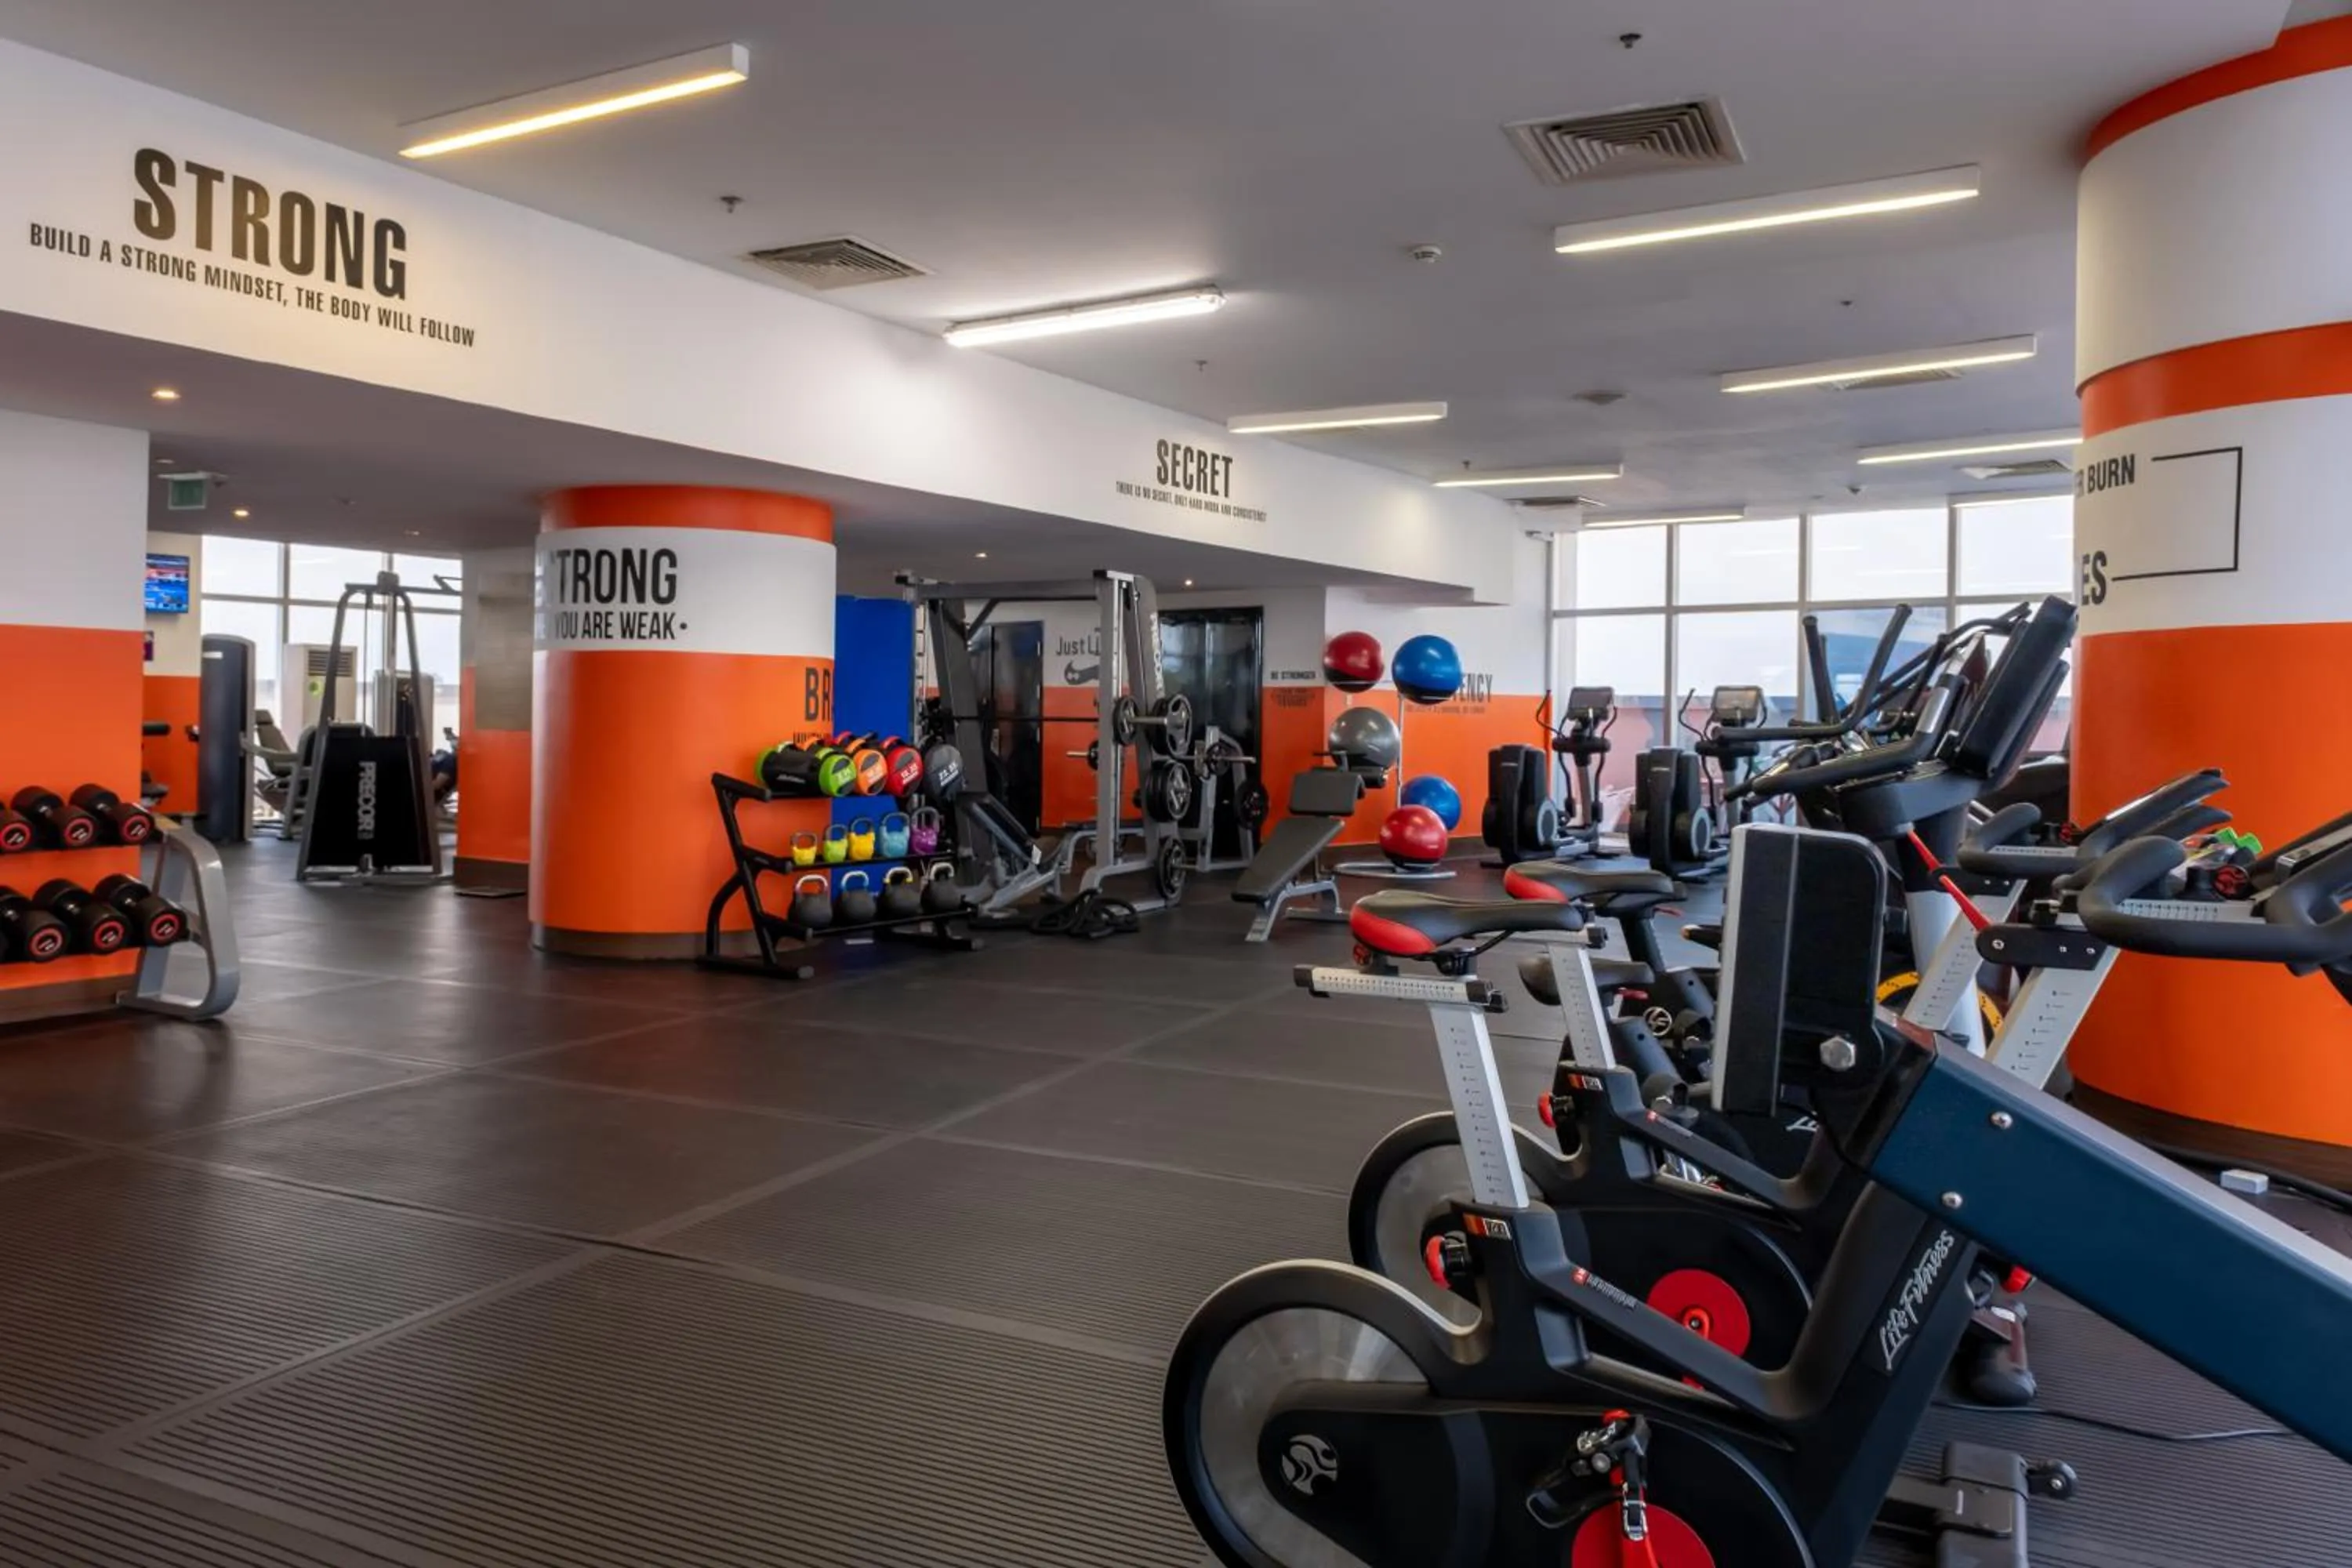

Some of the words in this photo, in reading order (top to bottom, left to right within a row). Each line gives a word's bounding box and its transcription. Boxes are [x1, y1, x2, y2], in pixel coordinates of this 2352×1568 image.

[133, 148, 407, 300] STRONG
[30, 223, 91, 258] BUILD
[100, 240, 112, 263] A
[121, 244, 196, 282] STRONG
[204, 264, 289, 308] MINDSET,
[296, 286, 325, 313] THE
[330, 296, 371, 323] BODY
[377, 306, 414, 333] WILL
[419, 317, 475, 347] FOLLOW
[1156, 438, 1233, 499] SECRET
[2087, 453, 2136, 495] BURN
[551, 547, 678, 605] TRONG
[582, 611, 614, 639] ARE
[1056, 634, 1085, 656] Just
[358, 760, 377, 831] PRECOR
